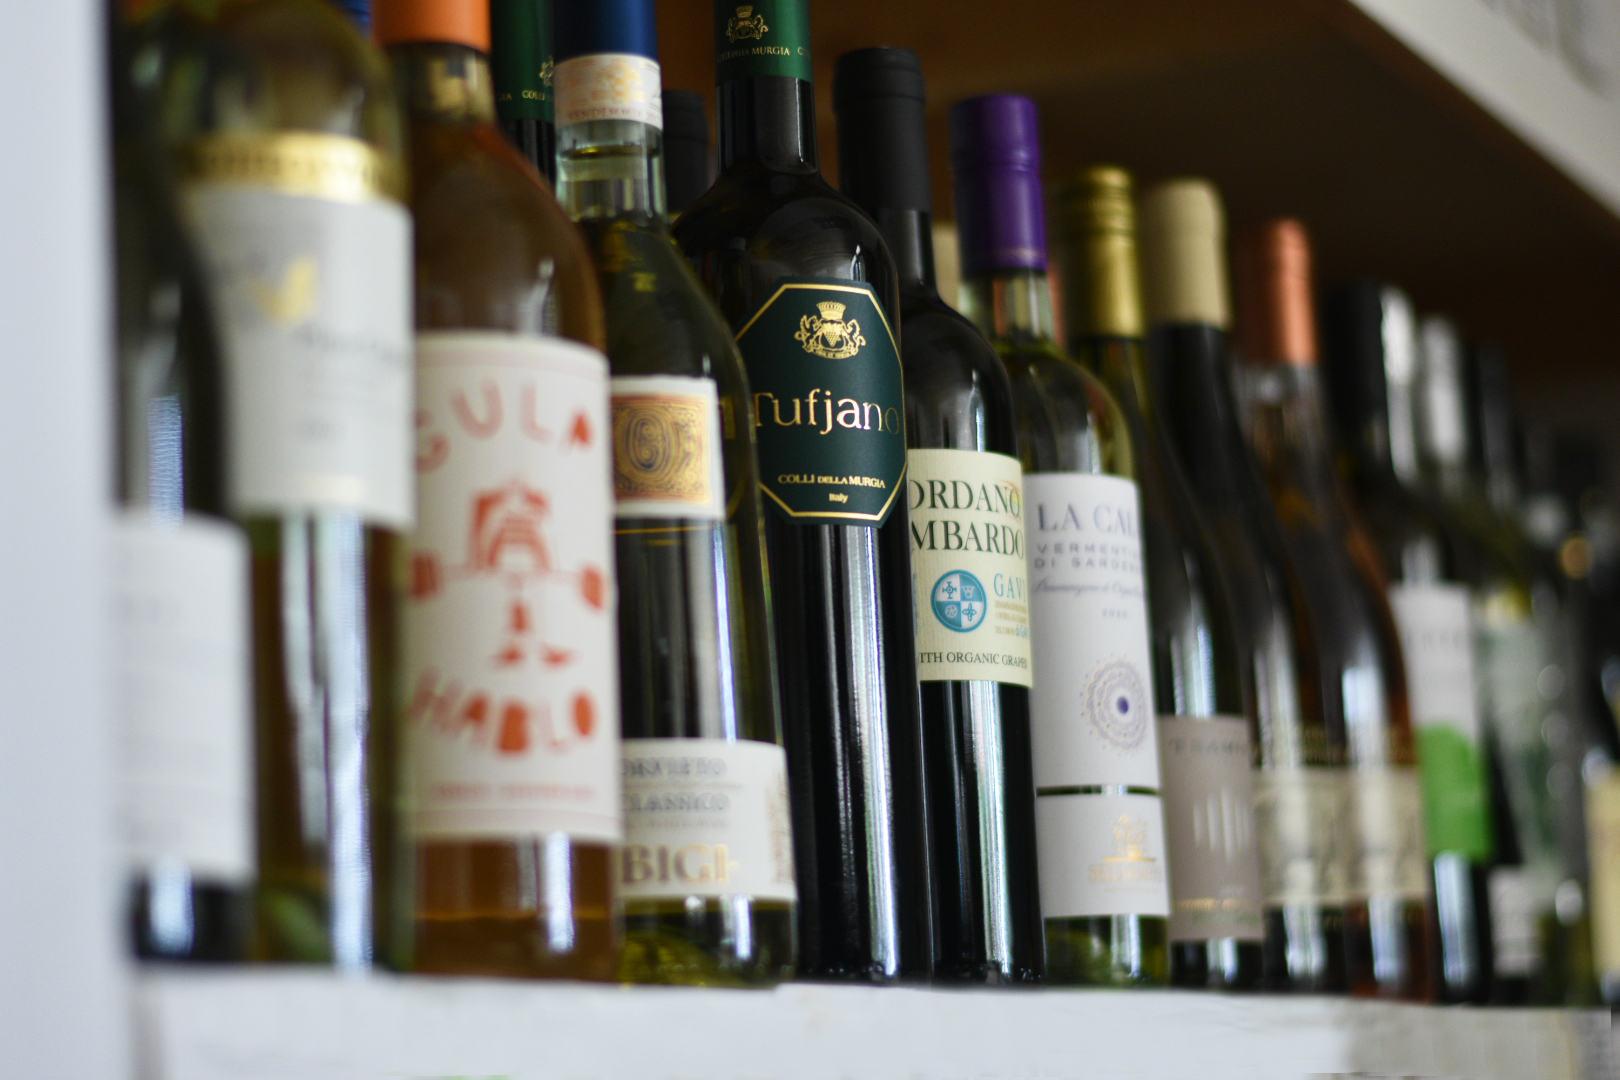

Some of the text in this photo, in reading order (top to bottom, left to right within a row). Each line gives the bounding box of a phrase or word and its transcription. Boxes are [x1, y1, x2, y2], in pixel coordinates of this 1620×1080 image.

[752, 46, 791, 56] MURGIA
[752, 388, 900, 436] Tufjano
[777, 473, 886, 489] COLLI DELLA MURGIA
[828, 492, 849, 504] Italy
[1037, 503, 1081, 532] LA
[993, 573, 1027, 603] GAVI
[919, 651, 1028, 669] ITH ORGANIC GRAPES
